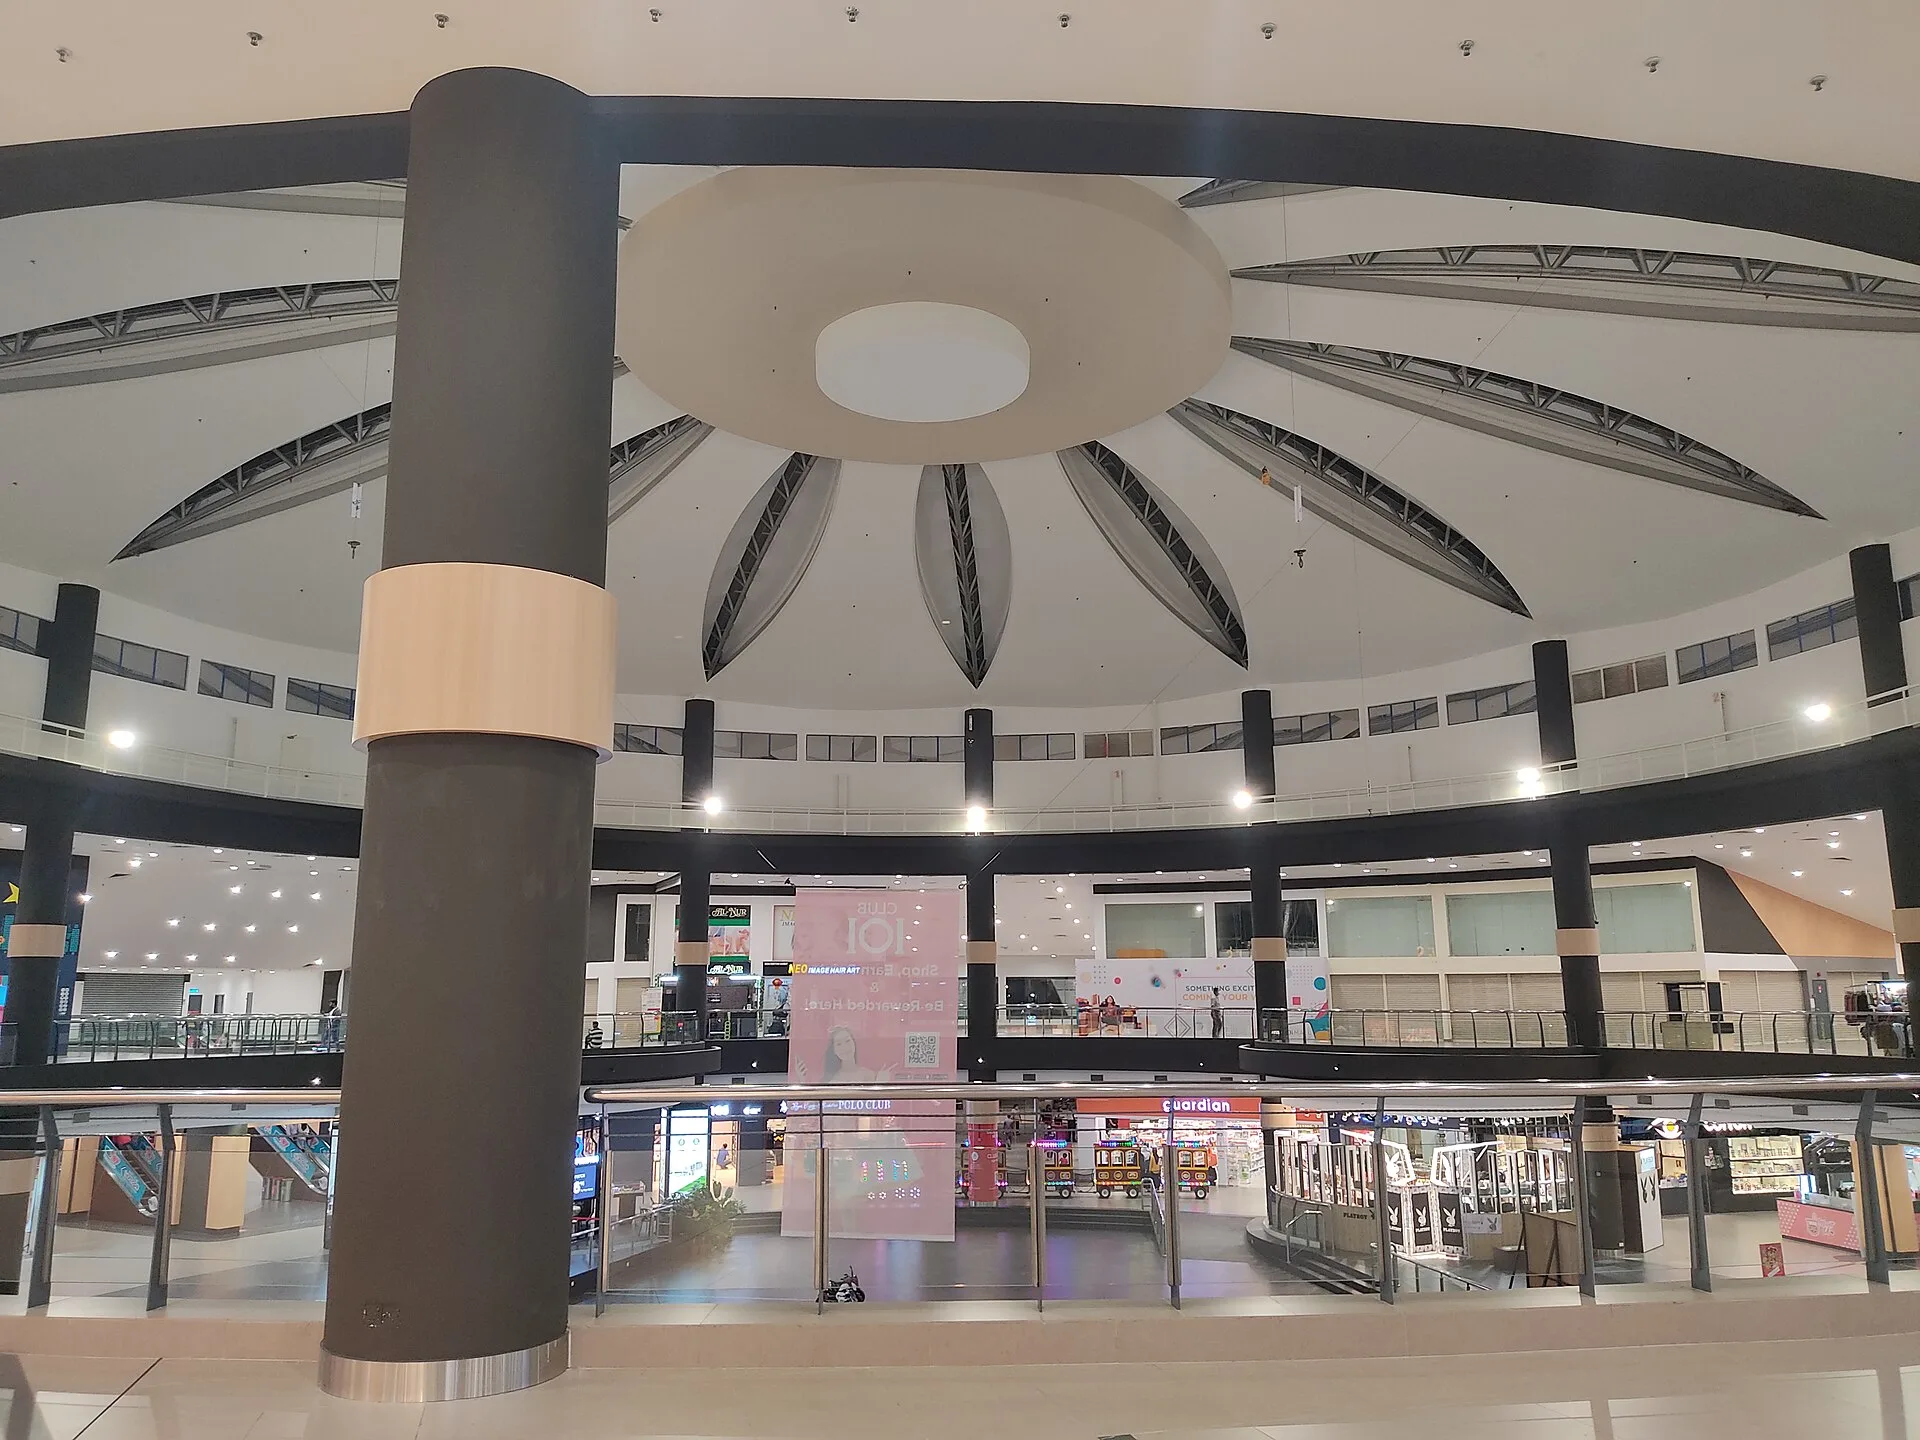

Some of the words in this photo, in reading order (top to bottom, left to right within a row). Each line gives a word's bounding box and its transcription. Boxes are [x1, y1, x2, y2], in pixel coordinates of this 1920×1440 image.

[787, 963, 808, 975] NEO
[808, 966, 831, 975] IMAGE
[830, 966, 847, 975] HAIR
[846, 966, 861, 975] ART
[1183, 993, 1213, 1001] COMIN
[1221, 993, 1248, 1001] YOUR
[838, 1099, 864, 1110] POLO
[865, 1099, 891, 1110] CLUB
[1162, 1098, 1231, 1113] guardian
